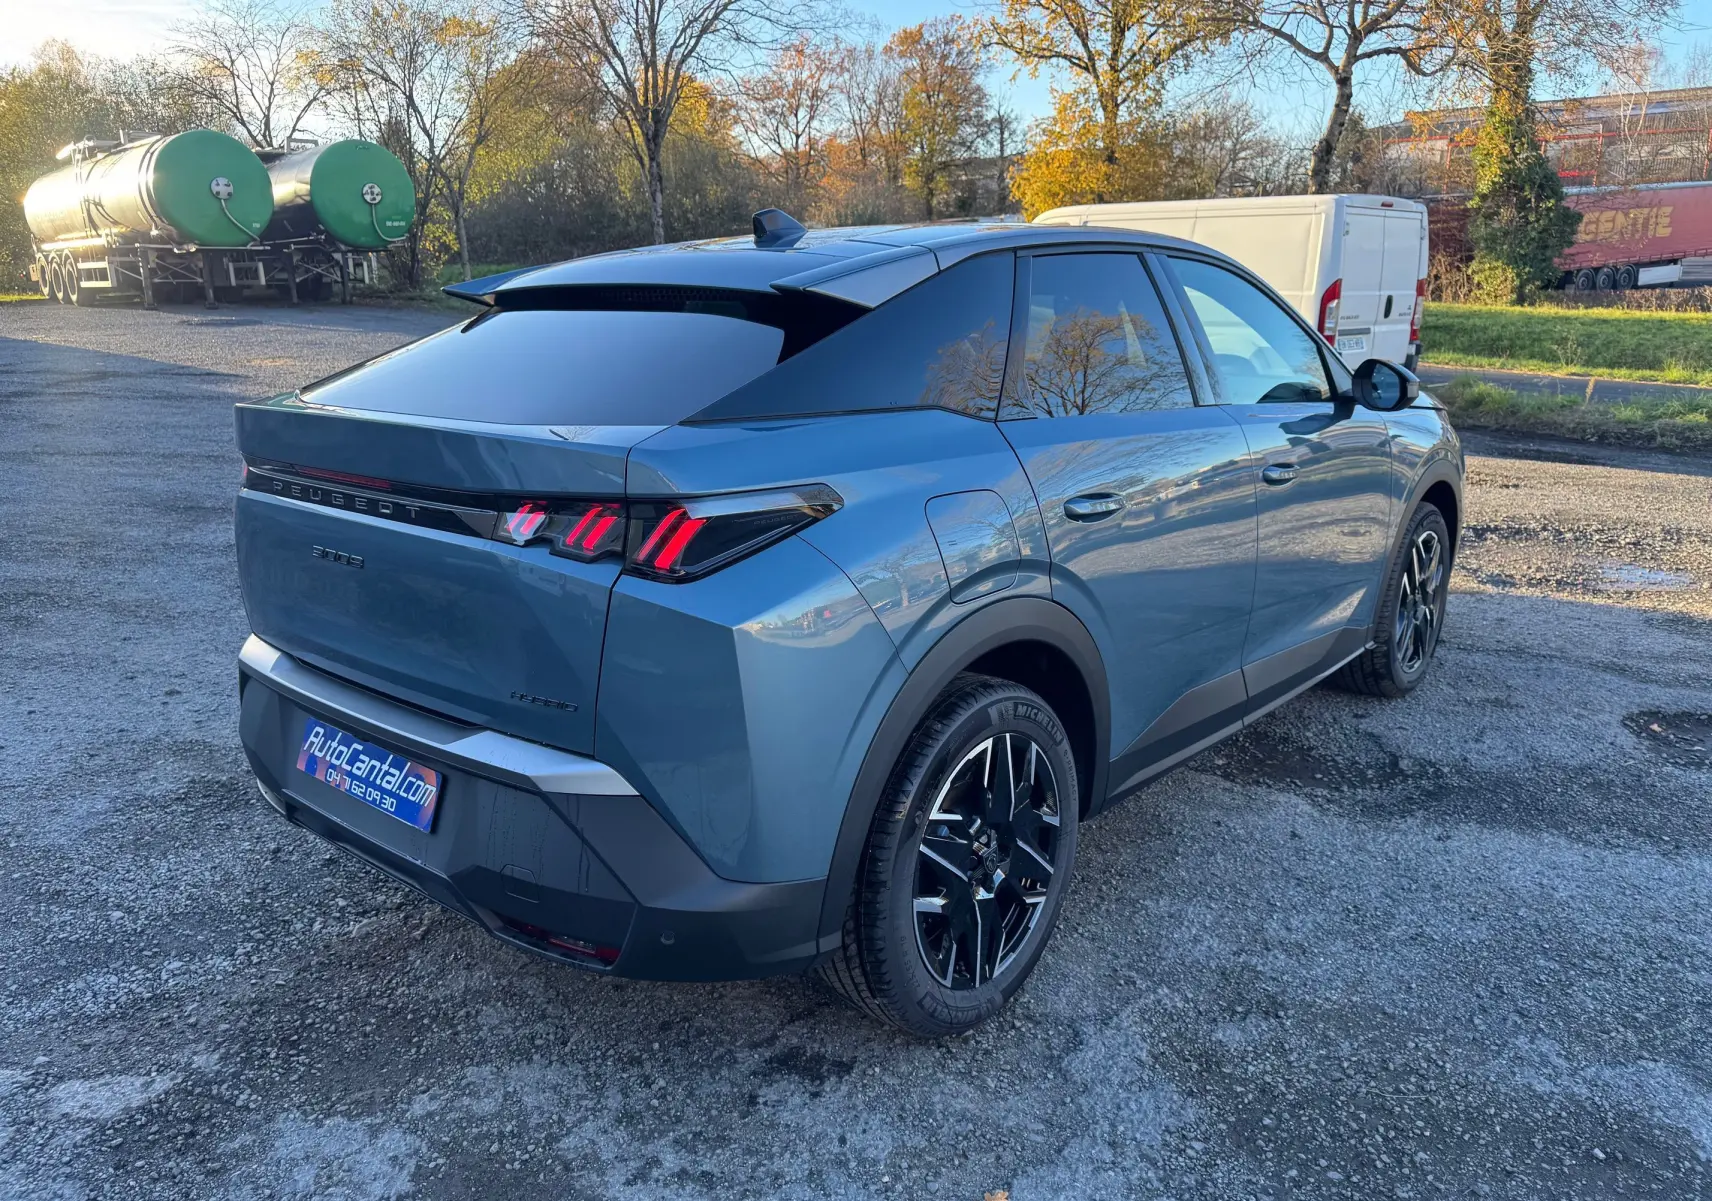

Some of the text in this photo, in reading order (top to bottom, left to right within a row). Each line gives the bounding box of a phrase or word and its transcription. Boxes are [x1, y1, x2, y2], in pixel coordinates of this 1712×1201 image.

[272, 480, 421, 519] PEUGEOT
[312, 545, 365, 569] 3008
[510, 690, 579, 713] HYBRID
[1015, 704, 1065, 744] MICHELIN
[303, 726, 437, 807] AutoCantal.com
[326, 768, 397, 812] 04 71 62 09 30
